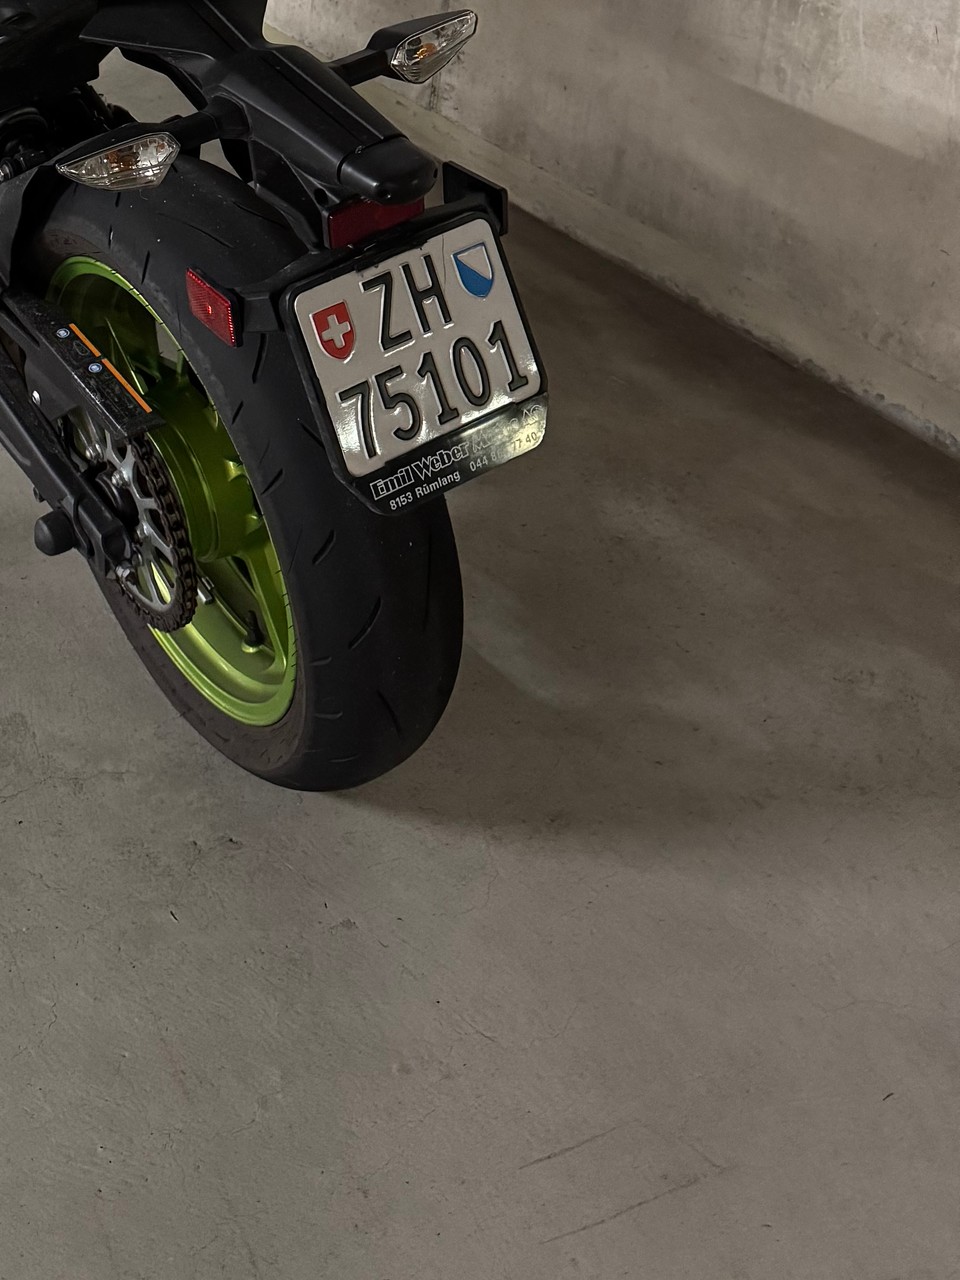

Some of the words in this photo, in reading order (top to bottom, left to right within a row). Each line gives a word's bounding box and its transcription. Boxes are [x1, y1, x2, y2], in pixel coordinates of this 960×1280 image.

[361, 254, 453, 352] ZH
[338, 320, 529, 459] 75101
[369, 466, 415, 501] Emil
[411, 442, 469, 481] Weber
[389, 492, 414, 511] 8153
[415, 471, 461, 499] Rümlang
[469, 457, 489, 472] 044
[525, 431, 538, 444] 40
